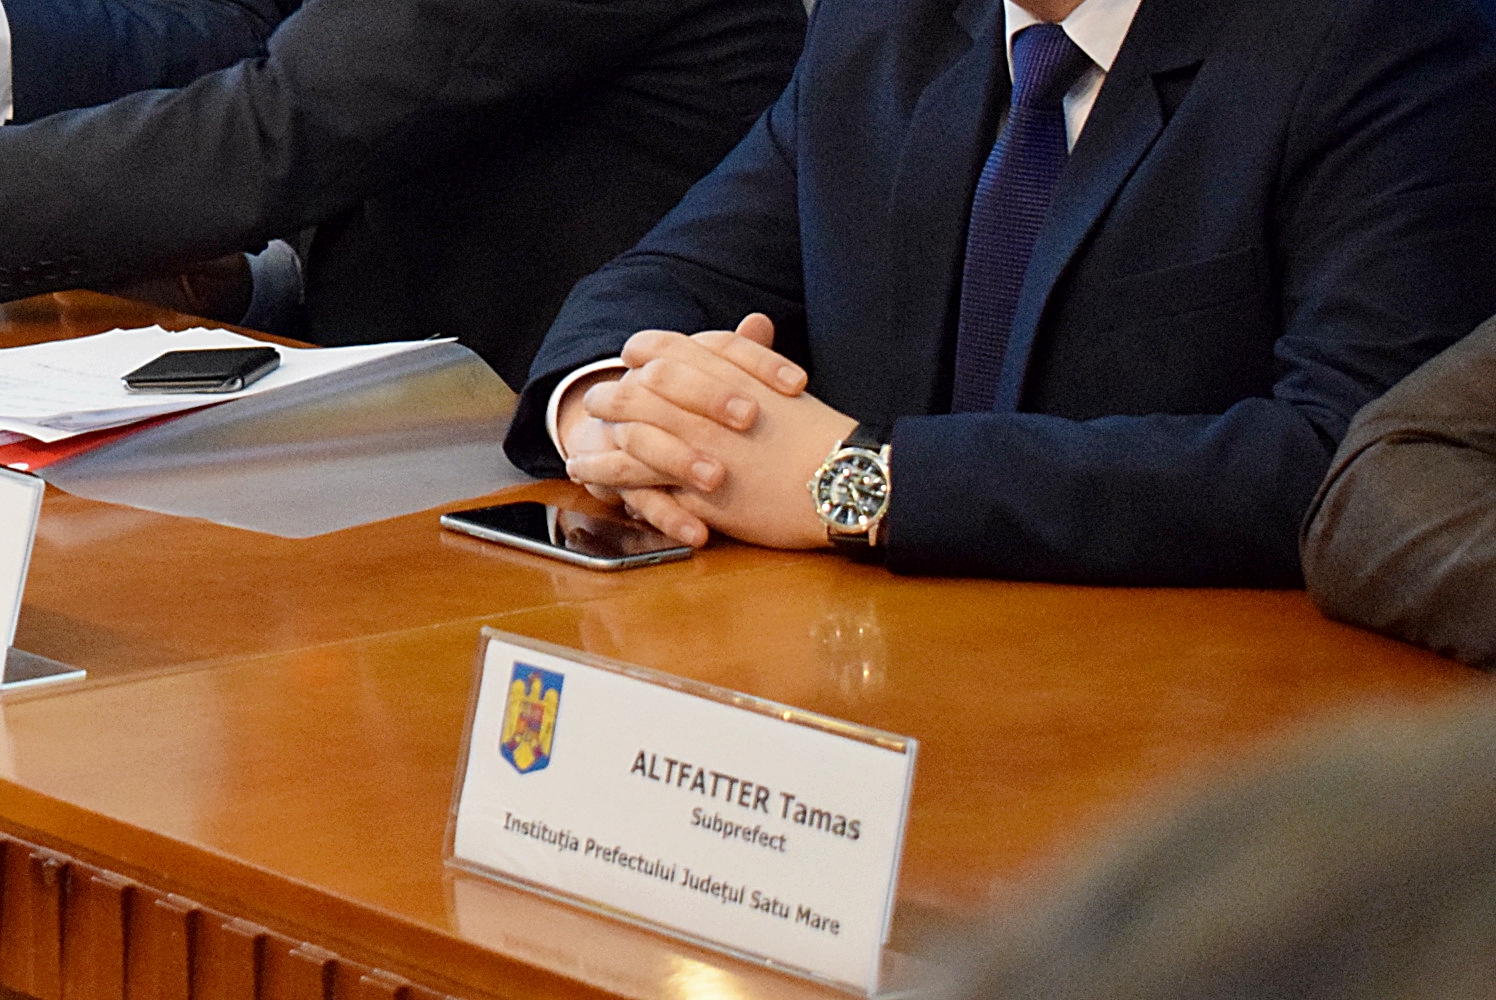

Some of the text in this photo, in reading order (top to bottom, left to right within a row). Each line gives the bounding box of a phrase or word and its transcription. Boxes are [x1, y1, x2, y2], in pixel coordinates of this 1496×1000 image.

[630, 749, 862, 841] ALTFATTER Tamas
[689, 806, 787, 852] Subprefect
[584, 837, 677, 883] Prefectului
[748, 889, 791, 920] Satu
[794, 903, 841, 935] Mare
